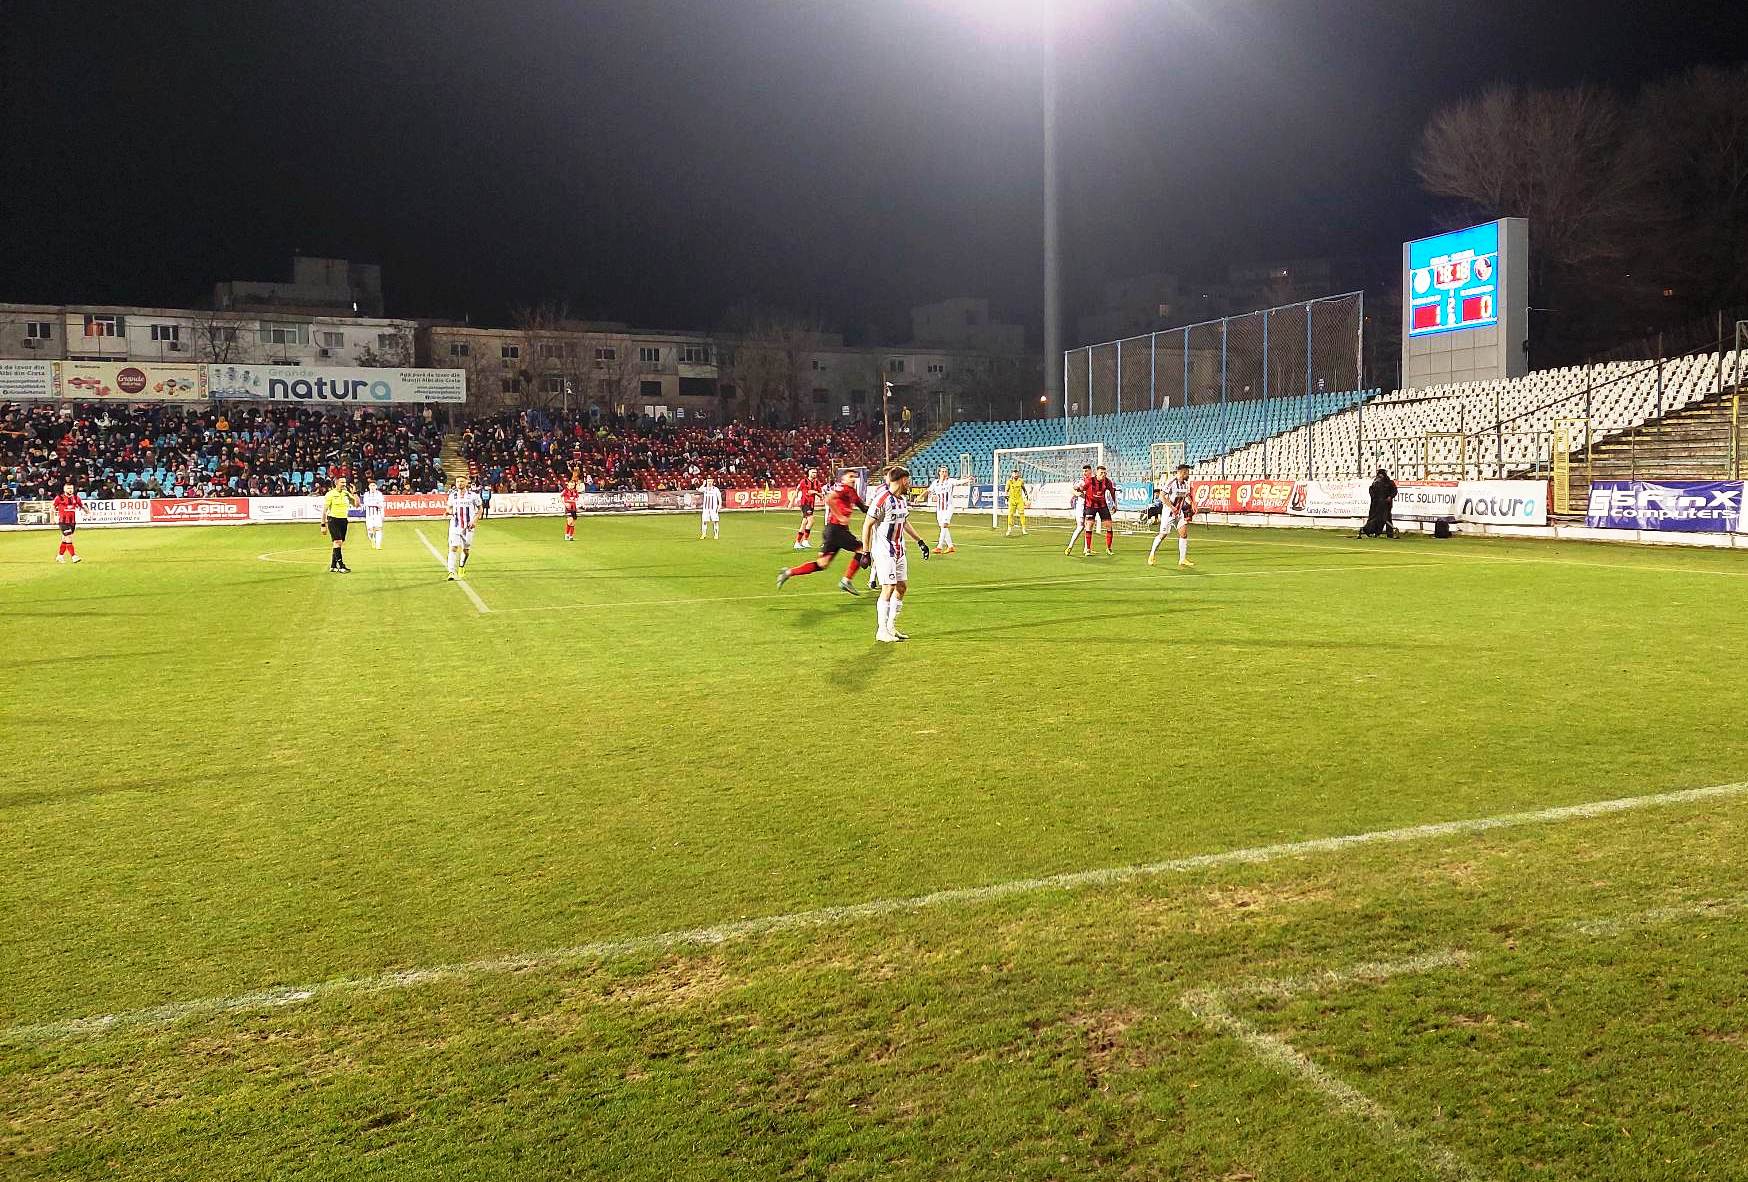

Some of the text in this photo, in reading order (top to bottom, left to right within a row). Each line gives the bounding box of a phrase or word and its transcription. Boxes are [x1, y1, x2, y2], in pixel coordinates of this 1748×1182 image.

[268, 377, 392, 401] natura
[120, 501, 149, 510] PROD
[1462, 497, 1535, 517] natura
[1610, 508, 1737, 520] computers
